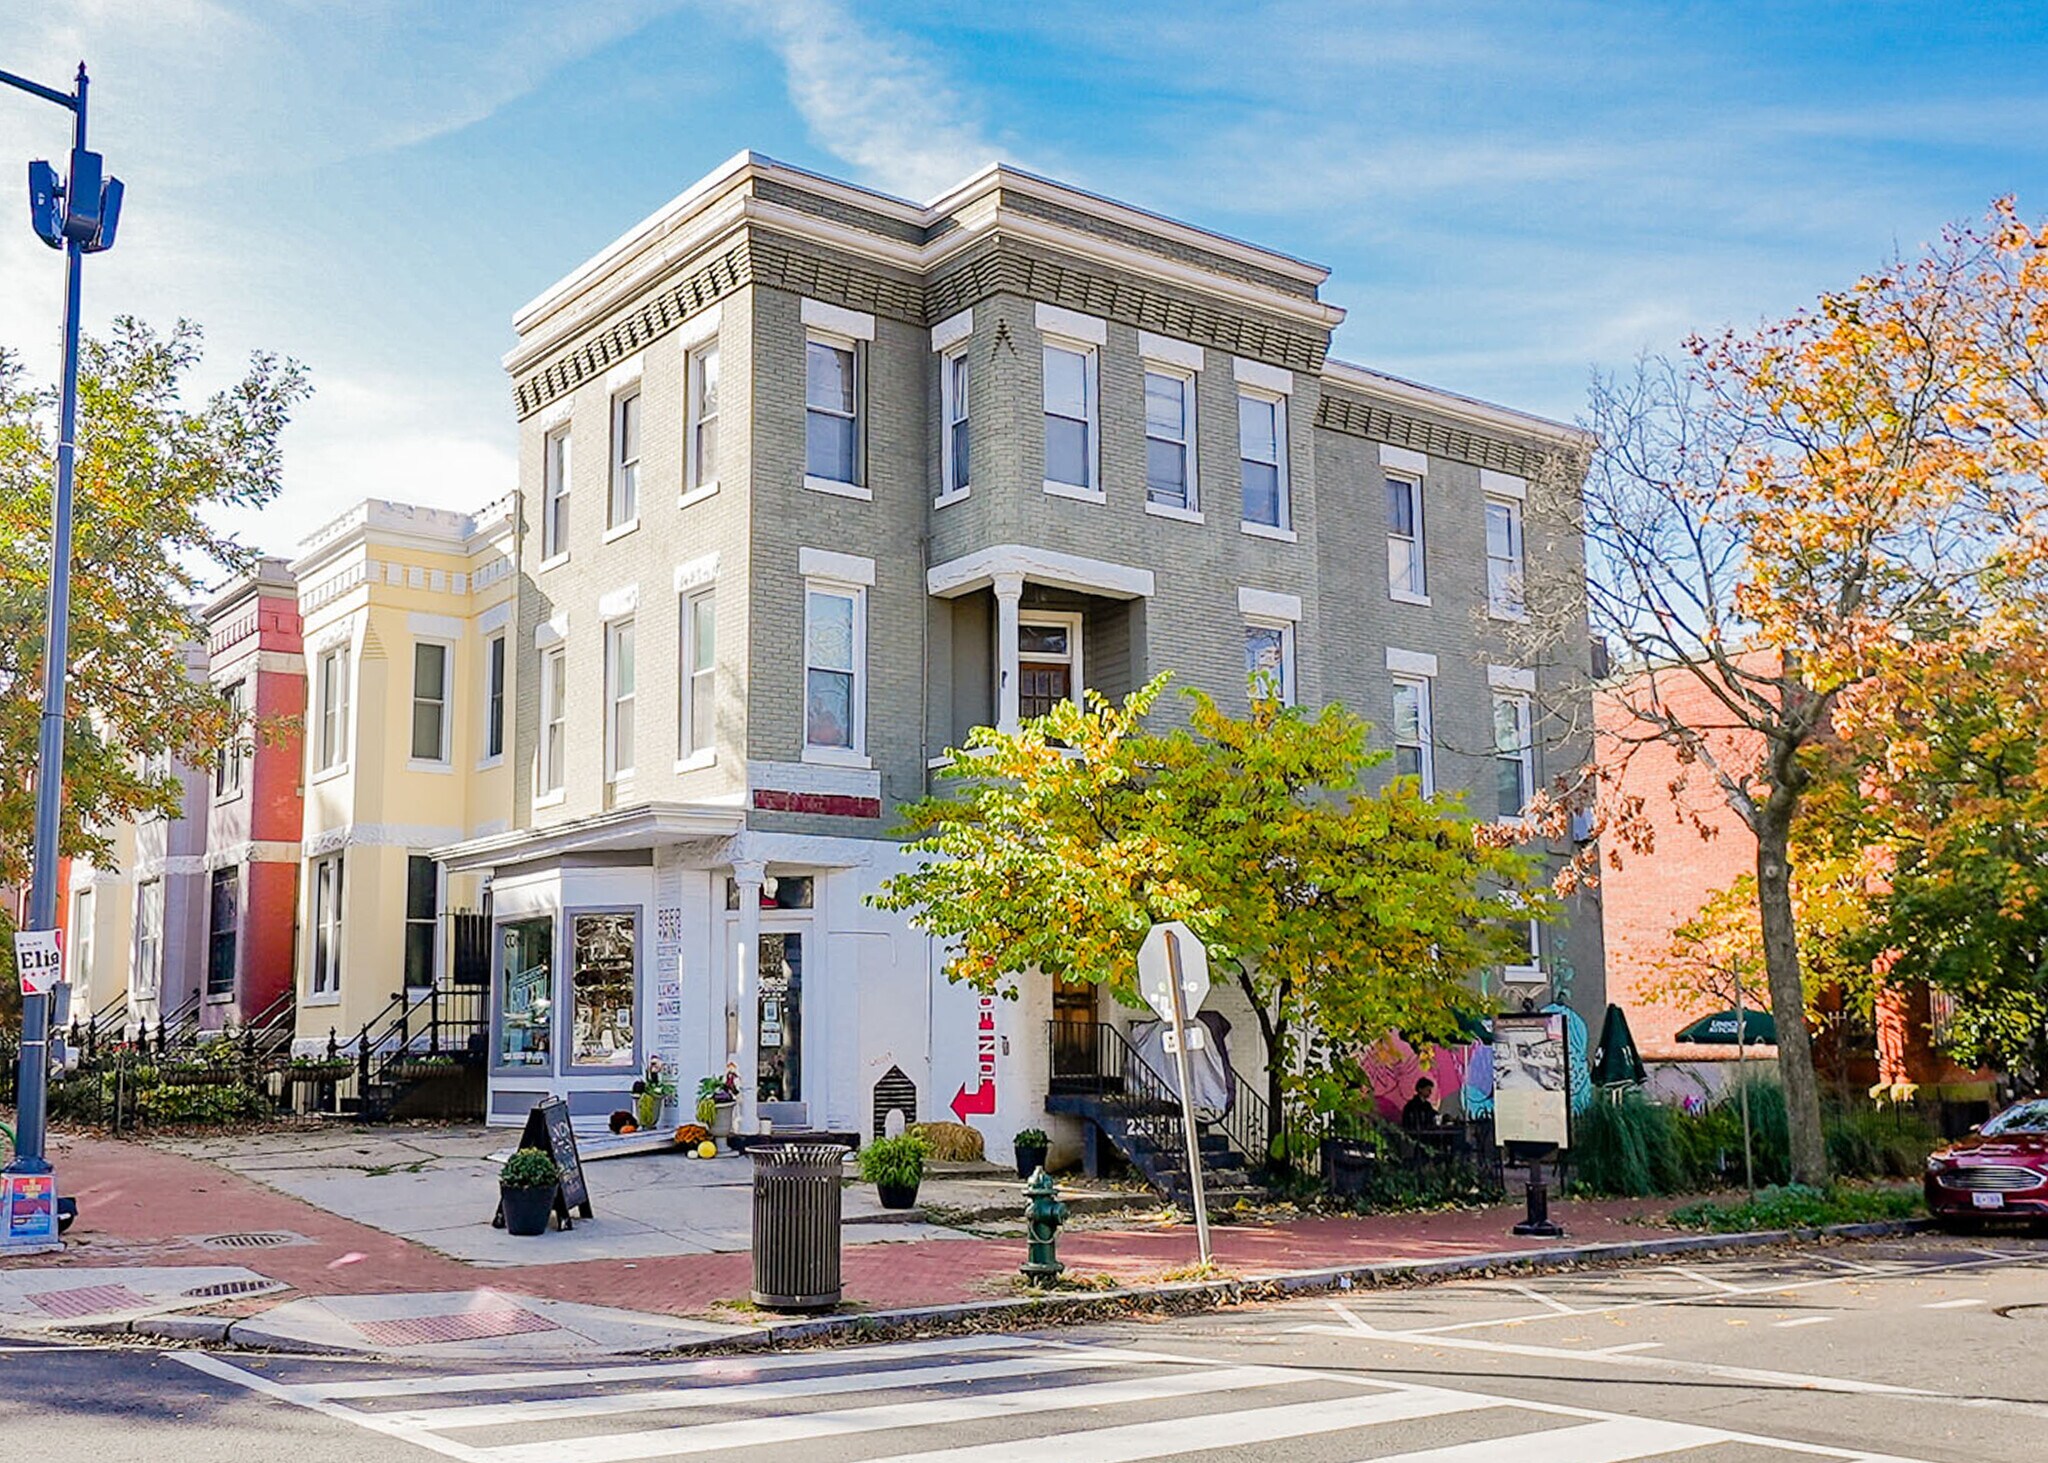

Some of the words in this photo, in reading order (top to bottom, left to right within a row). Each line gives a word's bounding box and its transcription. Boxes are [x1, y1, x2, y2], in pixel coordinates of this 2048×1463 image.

[658, 908, 681, 926] BEER
[657, 1001, 681, 1016] DINNER
[1711, 1019, 1746, 1029] UNIO
